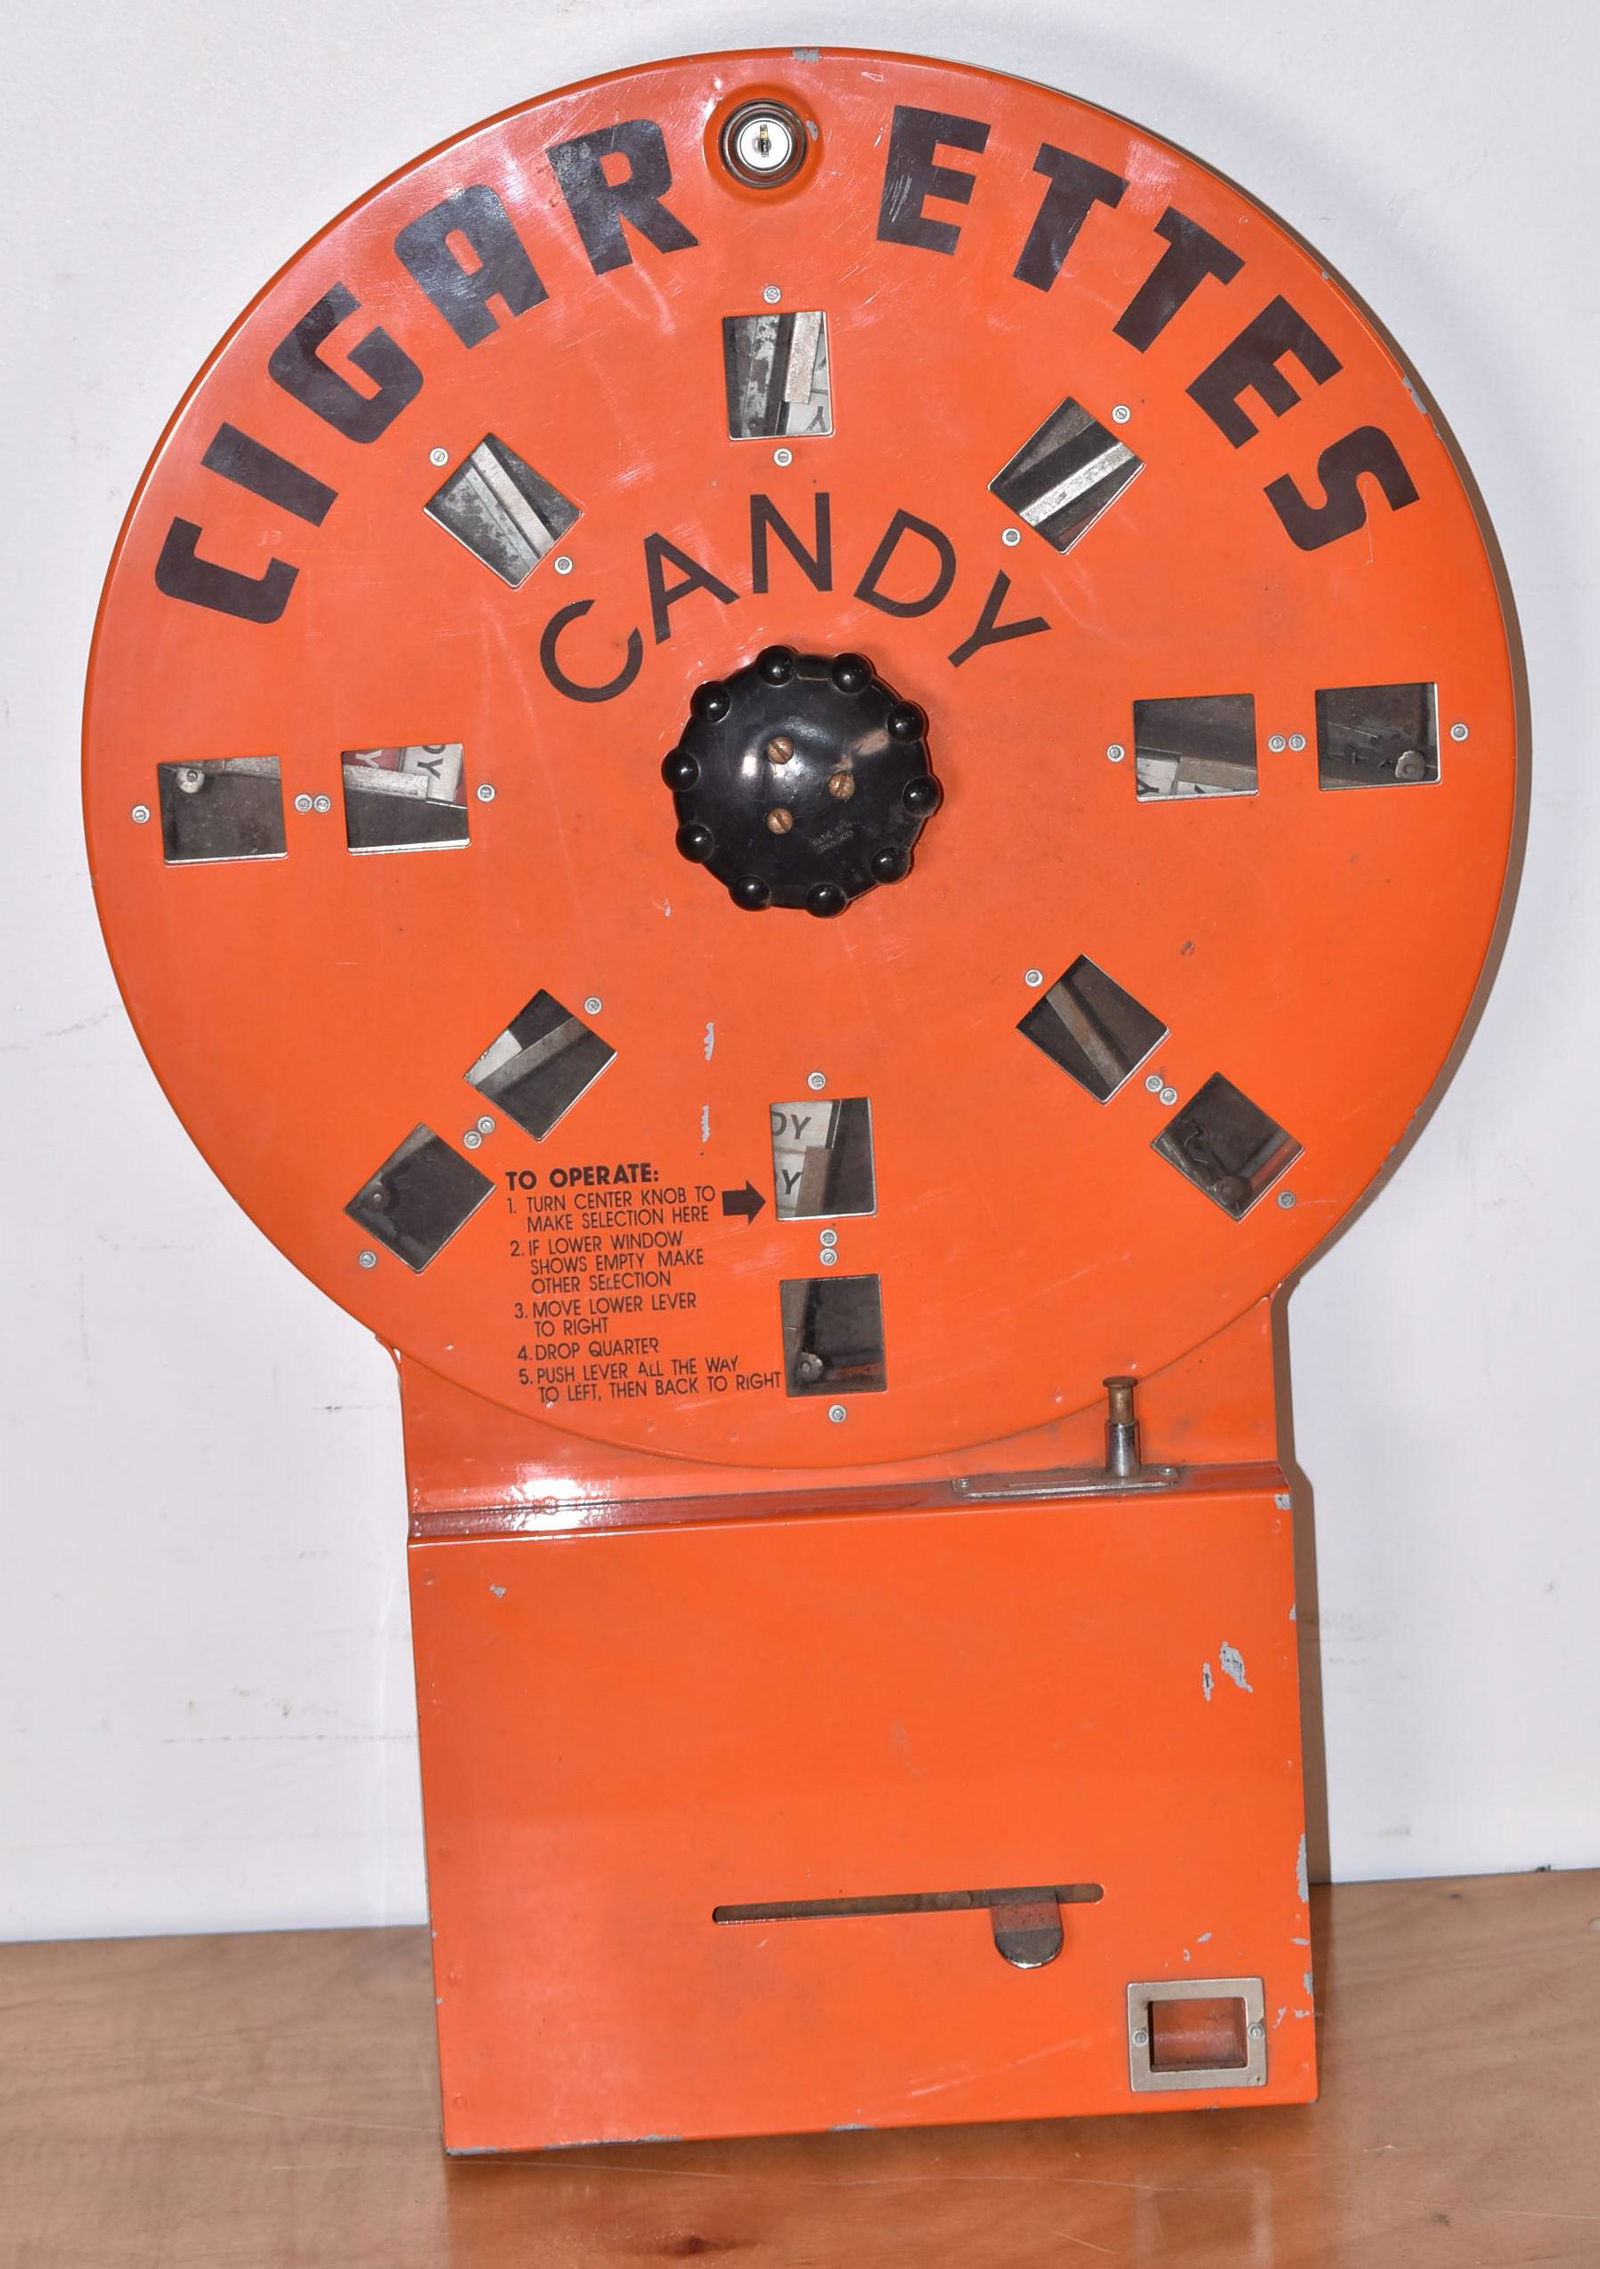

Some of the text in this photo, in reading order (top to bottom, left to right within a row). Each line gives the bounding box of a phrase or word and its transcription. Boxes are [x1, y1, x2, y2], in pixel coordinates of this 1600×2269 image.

[540, 493, 1050, 702] CANDY
[505, 1162, 658, 1191] TO OPERATE:
[507, 1185, 716, 1213] 1. TURN CENTER KNOB TO
[528, 1205, 708, 1232] MAKE SELECTION HERE
[510, 1230, 682, 1257] 2. IF LOWER WINDOW
[531, 1249, 704, 1275] SHOWS EMPTY MAKE
[532, 1270, 671, 1294] OTHER SELECTION
[514, 1292, 696, 1320] 3. MOVE LOWER LEVER
[534, 1317, 608, 1337] TO RIGHT
[517, 1337, 659, 1361] 4. DROP QUARTER
[519, 1355, 738, 1385] 5. PUSH LEVER ALL THE WAY
[538, 1372, 781, 1404] TO LEFT, THEN BACK TO RIGHT
